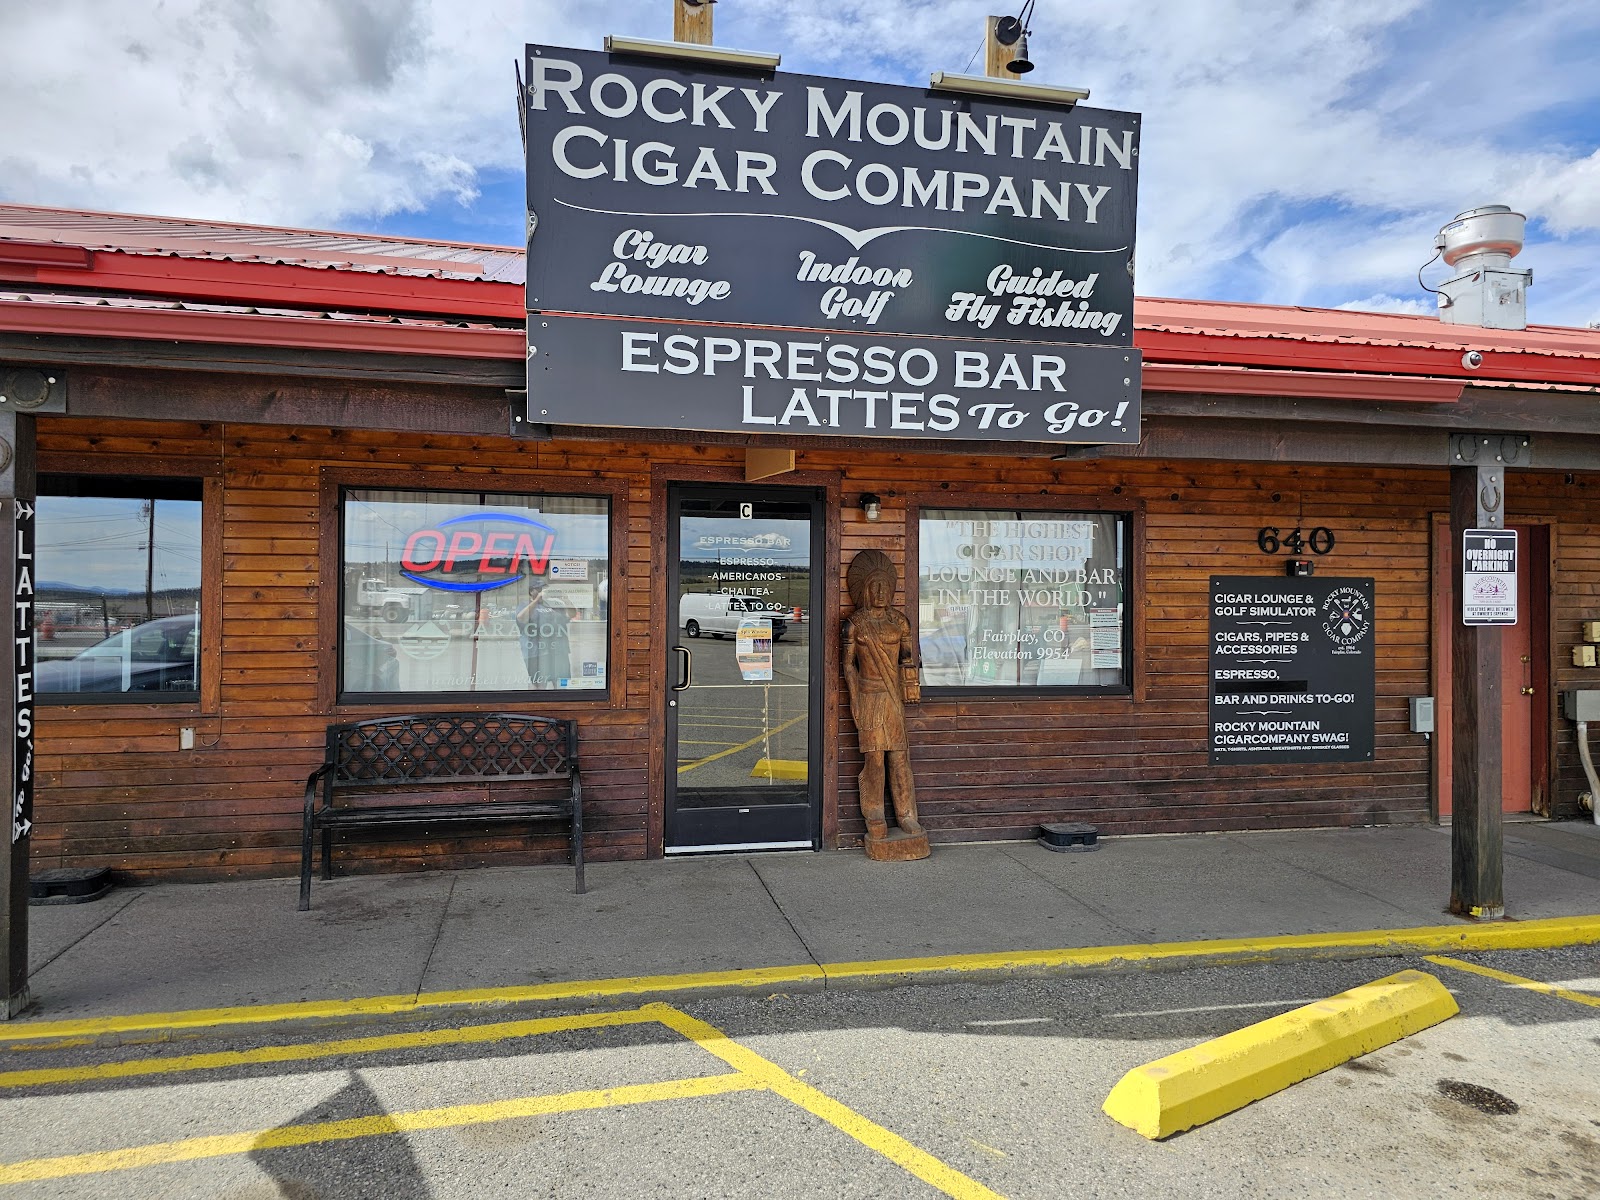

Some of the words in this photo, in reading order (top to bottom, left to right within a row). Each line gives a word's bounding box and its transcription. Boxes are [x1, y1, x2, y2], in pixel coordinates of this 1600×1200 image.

[531, 56, 783, 133] ROCKY
[805, 86, 1134, 171] MOUNTAIN
[552, 125, 779, 196] CIGAR
[801, 149, 1112, 224] COMPANY
[612, 228, 709, 269] Cigar
[797, 250, 913, 289] Indoor
[590, 261, 732, 306] Lounge
[986, 264, 1100, 300] Guided
[819, 286, 896, 326] Golf
[944, 291, 1000, 331] Fly
[1006, 294, 1123, 337] Fishing
[620, 331, 938, 387] ESPRESSO
[954, 350, 1067, 393] BAR
[741, 385, 961, 432] LATTES
[967, 403, 1032, 430] To
[1043, 400, 1131, 435] Go!
[741, 504, 751, 518] C
[946, 520, 1000, 538] "THE
[1003, 521, 1099, 540] HIGHEST
[699, 536, 765, 546] ESPRESSO
[767, 537, 792, 546] BAR
[1257, 526, 1335, 555] 640
[1484, 538, 1497, 549] NO
[401, 529, 556, 576] OPEN
[955, 543, 1025, 561] CIGAR
[1028, 544, 1088, 564] SHOP,
[1466, 549, 1515, 561] OVERNIGHT
[1471, 560, 1509, 572] PARKING
[707, 572, 787, 581] -AMERICANOS-
[926, 565, 1018, 583] LOUNGE
[1023, 568, 1070, 584] AND
[1075, 568, 1117, 585] BAR
[716, 587, 747, 596] -CHAI
[750, 587, 774, 596] TEA-
[937, 588, 962, 606] IN
[967, 589, 1010, 606] THE
[1214, 594, 1252, 604] CIGAR
[1254, 594, 1304, 604] LOUNGE
[1305, 594, 1314, 604] &
[1322, 588, 1339, 611] ROCKY
[1339, 587, 1370, 610] MOUNTAIN
[750, 602, 764, 611] TO
[766, 602, 787, 611] GO-
[1214, 606, 1247, 617] GOLF
[1249, 606, 1317, 617] SIMULATOR
[15, 530, 33, 739] LATTES
[461, 623, 571, 639] PARAGON
[982, 629, 1039, 645] Fairplay,
[1043, 629, 1066, 643] CO
[1214, 632, 1263, 643] CIGARS,
[1265, 632, 1299, 642] PIPES
[1300, 632, 1309, 642] &
[1322, 622, 1341, 644] CIGAR
[1341, 620, 1370, 645] COMPANY
[972, 647, 1033, 660] Elevation
[1214, 644, 1298, 655] ACCESSORIES
[1214, 669, 1280, 681] ESPRESSO,
[1214, 695, 1240, 705] BAR
[1242, 695, 1268, 704] AND
[1270, 694, 1314, 704] DRINKS
[1315, 693, 1355, 704] TO-GO!
[1214, 722, 1257, 732] ROCKY
[1258, 721, 1320, 731] MOUNTAIN
[1214, 734, 1310, 745] CIGARCOMPANY
[1311, 732, 1349, 744] SWAG!
